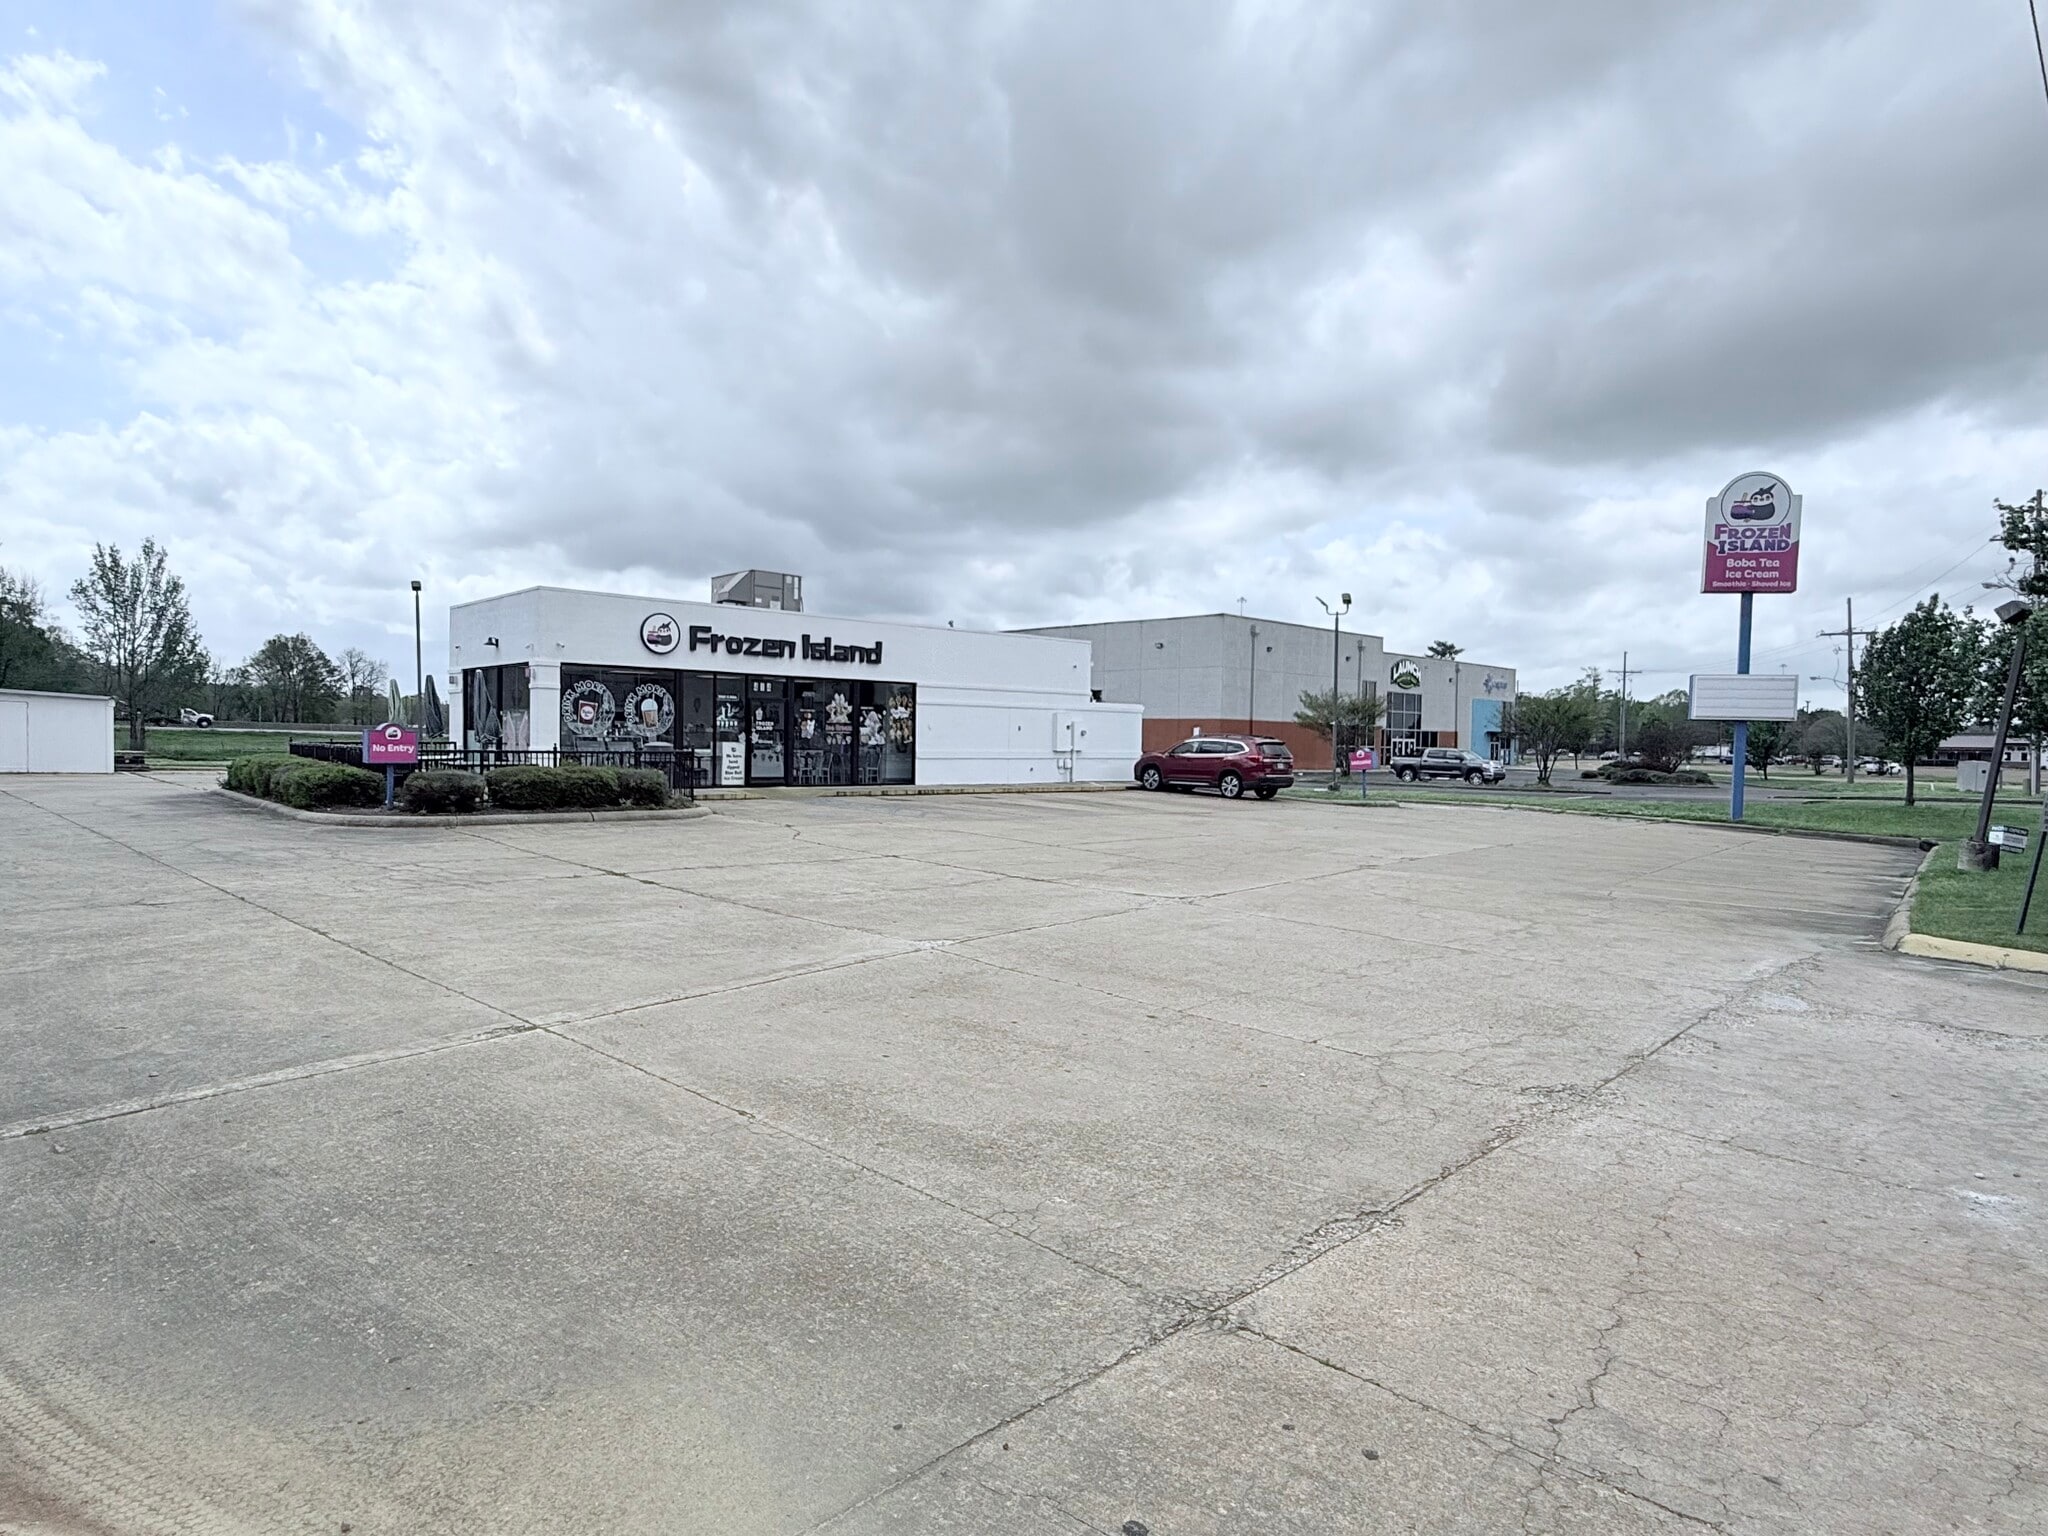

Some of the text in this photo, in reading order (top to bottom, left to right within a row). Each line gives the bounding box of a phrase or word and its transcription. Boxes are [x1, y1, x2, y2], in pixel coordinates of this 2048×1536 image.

[1714, 523, 1792, 540] FROZEN
[1718, 540, 1791, 555] ISLAND
[1726, 558, 1780, 568] Boba Tea
[1725, 569, 1780, 579] Ice Cream
[1712, 580, 1747, 588] Smoothie
[1751, 580, 1779, 588] Shaved
[689, 625, 884, 665] Frozen Island
[1392, 660, 1422, 682] LAUNCH
[574, 679, 607, 695] MORE
[372, 743, 415, 754] No Entry
